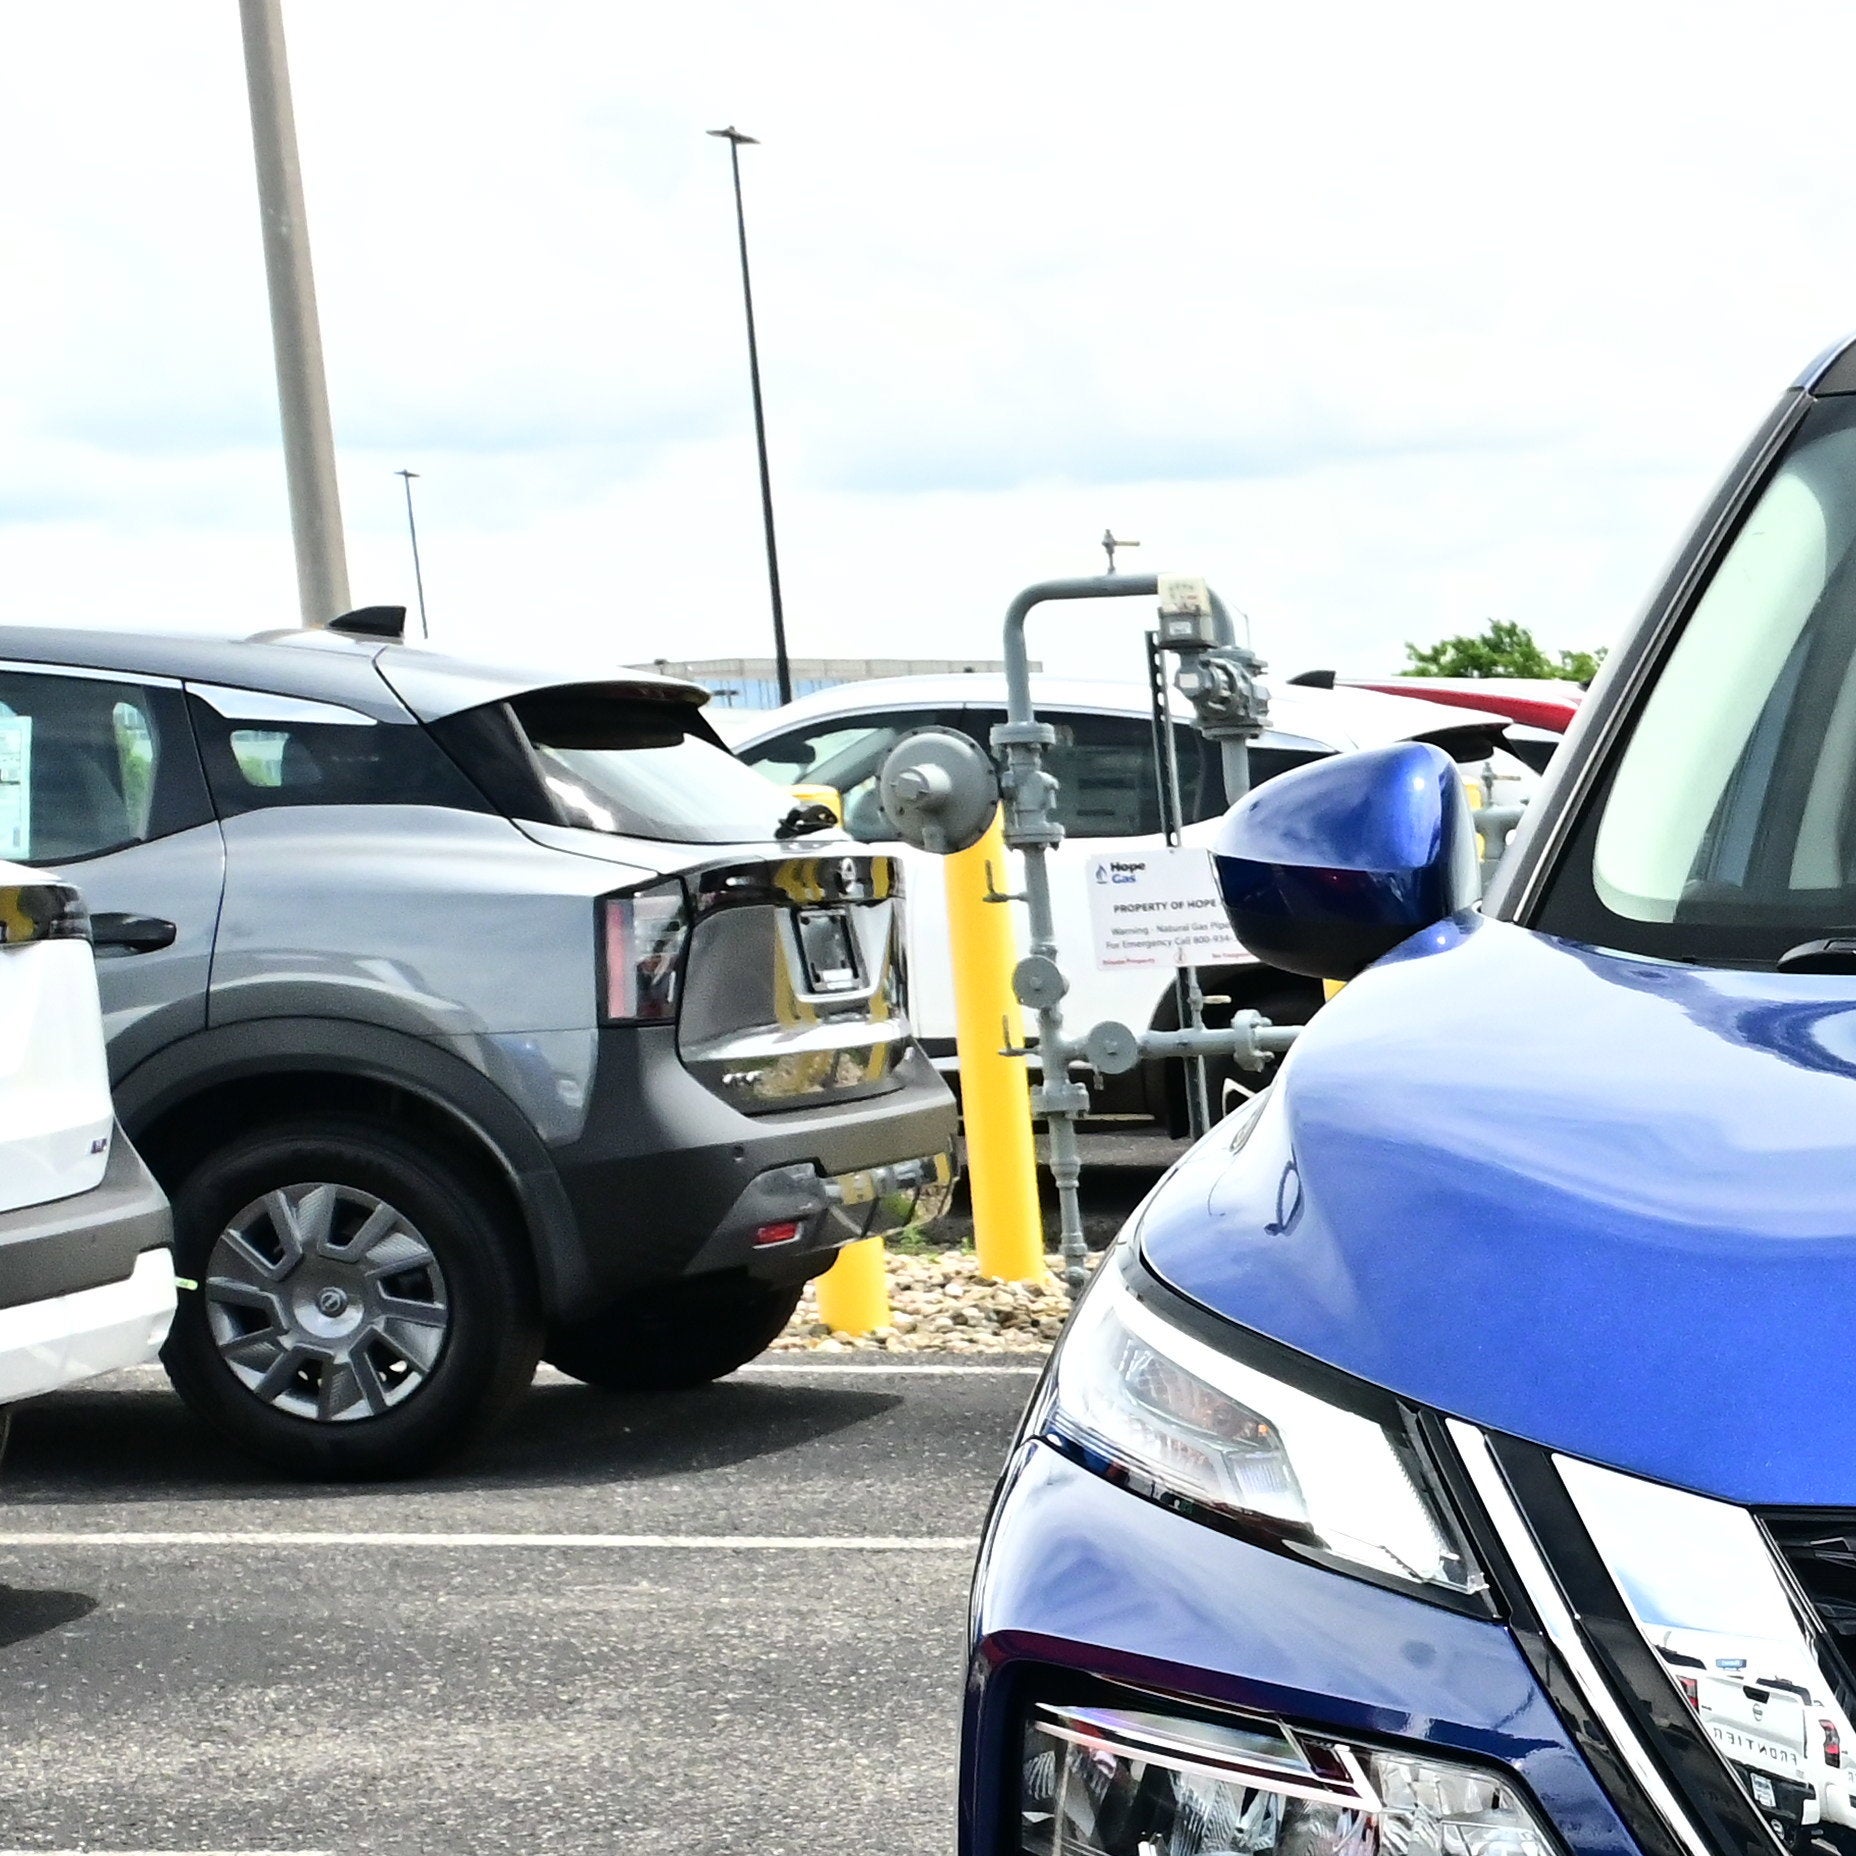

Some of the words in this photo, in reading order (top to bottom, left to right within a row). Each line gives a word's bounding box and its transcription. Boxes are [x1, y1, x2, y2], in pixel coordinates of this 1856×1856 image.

[1110, 862, 1145, 873] Hope
[1111, 874, 1136, 883] Gas
[1113, 902, 1168, 913] PROPERTY
[1170, 901, 1185, 910] OF
[1187, 899, 1217, 909] HOPE
[1111, 926, 1149, 936] Warning
[1156, 923, 1190, 933] Natural
[1191, 922, 1209, 932] Gas
[1106, 941, 1120, 949] For
[1122, 939, 1172, 950] Emergency
[1174, 937, 1191, 946] Call
